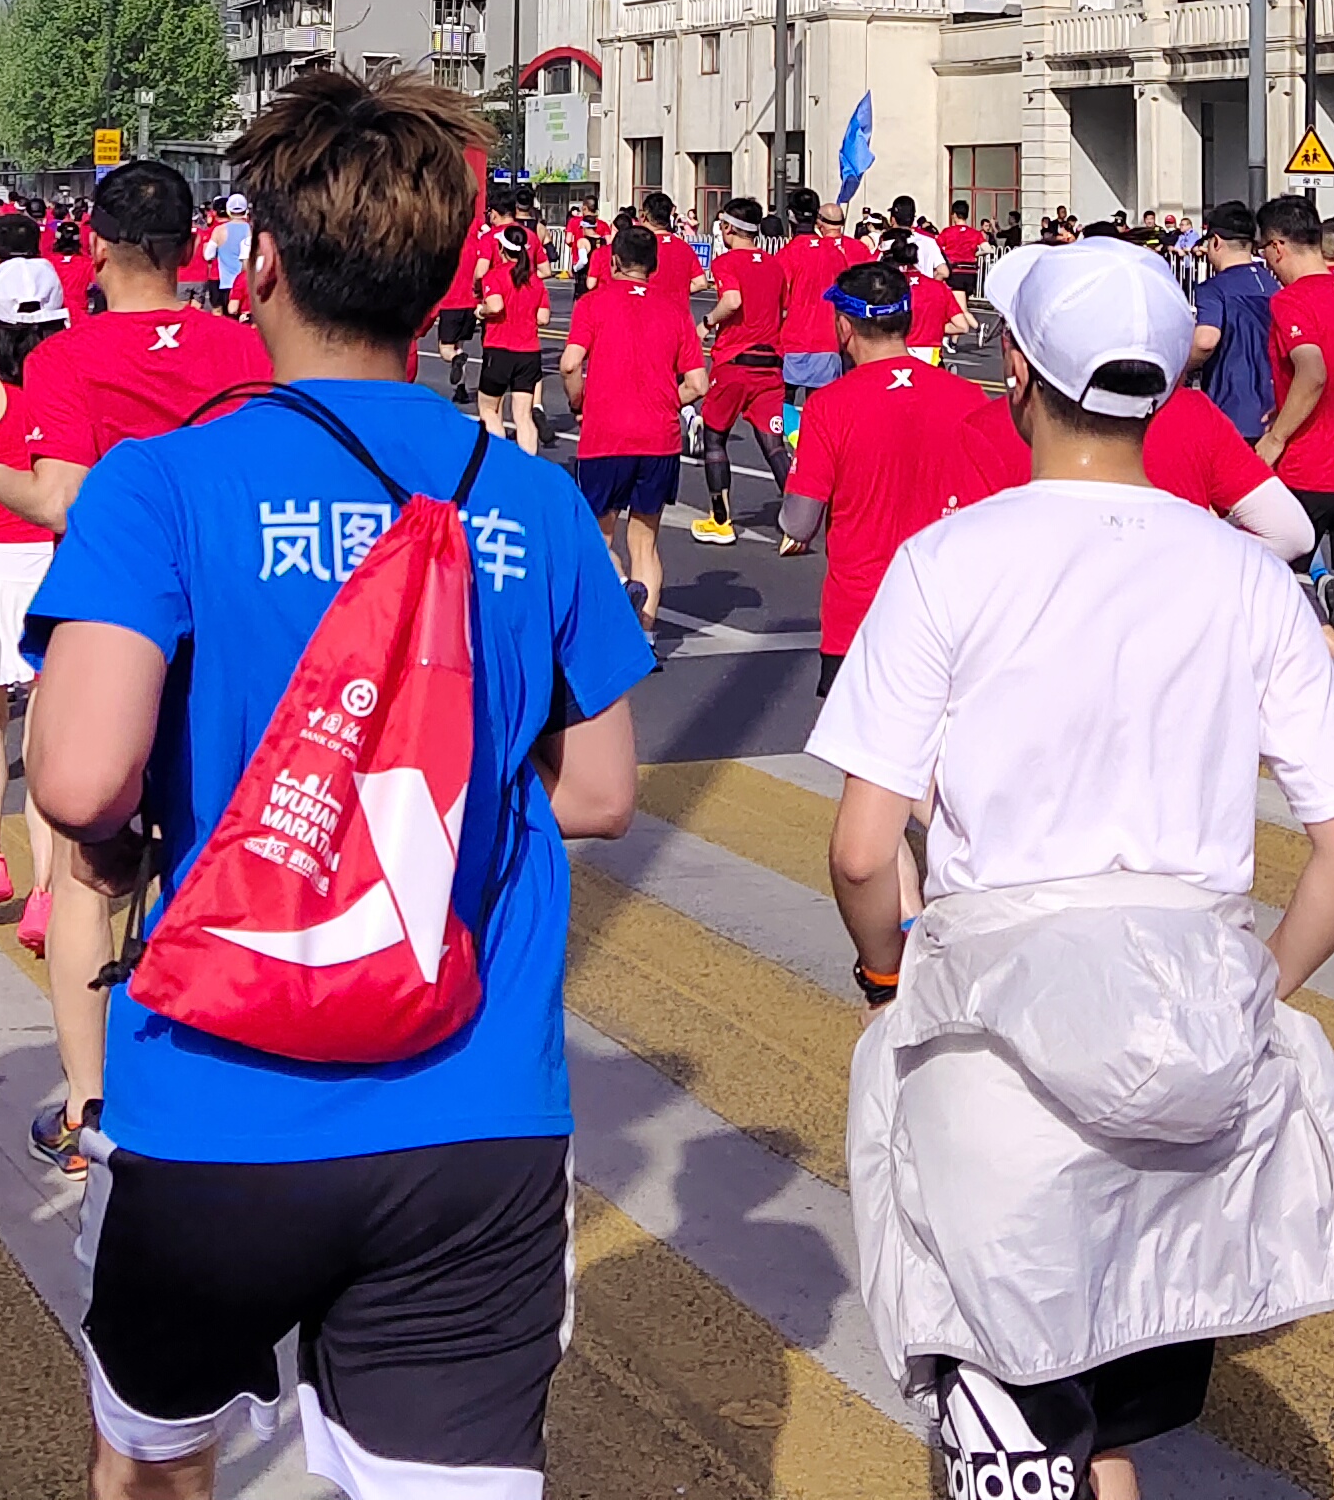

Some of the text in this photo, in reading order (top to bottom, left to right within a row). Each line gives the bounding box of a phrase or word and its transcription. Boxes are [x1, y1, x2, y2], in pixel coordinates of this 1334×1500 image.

[258, 499, 527, 593] 岚图车
[307, 706, 366, 747] 中国银
[270, 783, 340, 837] WUHAN
